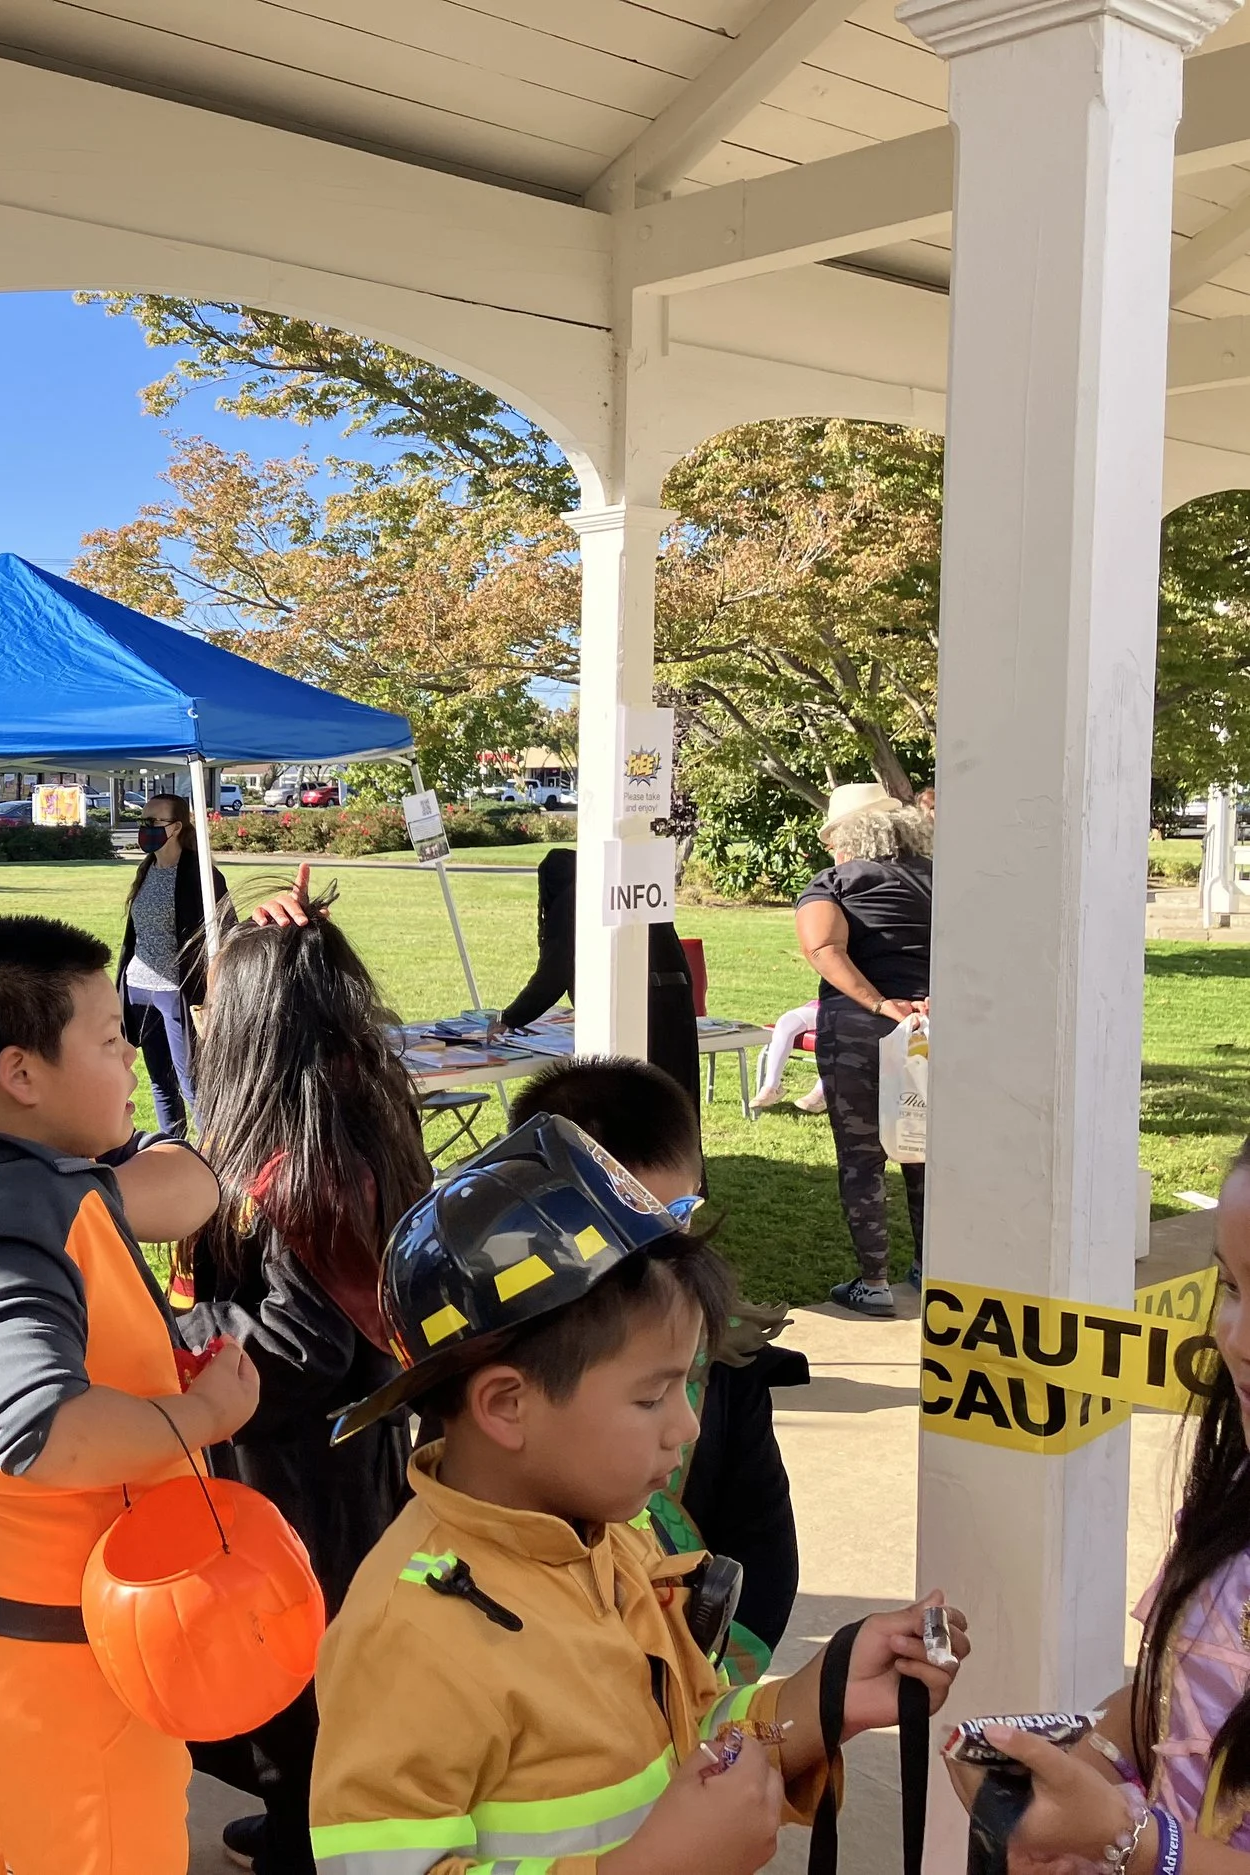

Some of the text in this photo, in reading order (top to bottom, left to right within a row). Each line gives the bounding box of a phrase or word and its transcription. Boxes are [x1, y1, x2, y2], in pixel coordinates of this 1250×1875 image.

[626, 752, 661, 777] FREE!
[623, 791, 661, 801] Please take
[625, 803, 637, 812] and
[610, 883, 667, 911] INFO.
